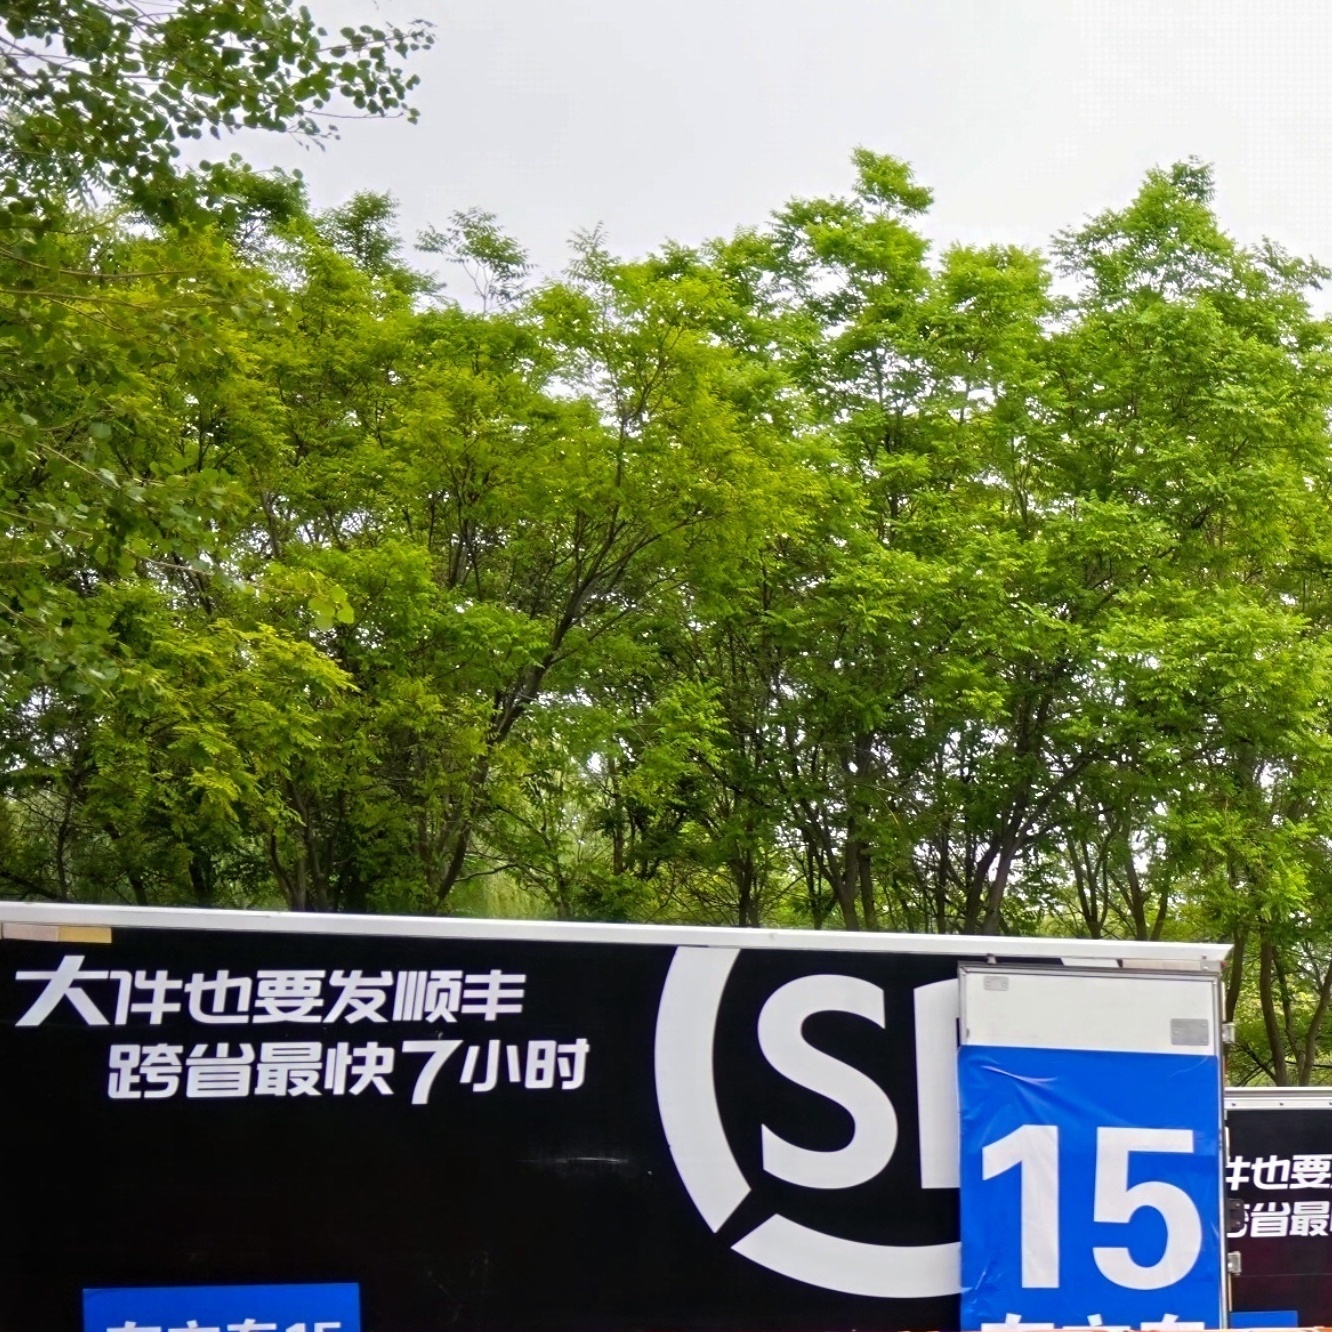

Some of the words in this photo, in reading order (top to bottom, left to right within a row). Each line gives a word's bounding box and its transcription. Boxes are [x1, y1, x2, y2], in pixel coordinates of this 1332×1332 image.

[15, 955, 527, 1027] 大件也要发顺丰
[107, 1038, 590, 1105] 跨省最快7小时
[981, 1124, 1202, 1290] 15
